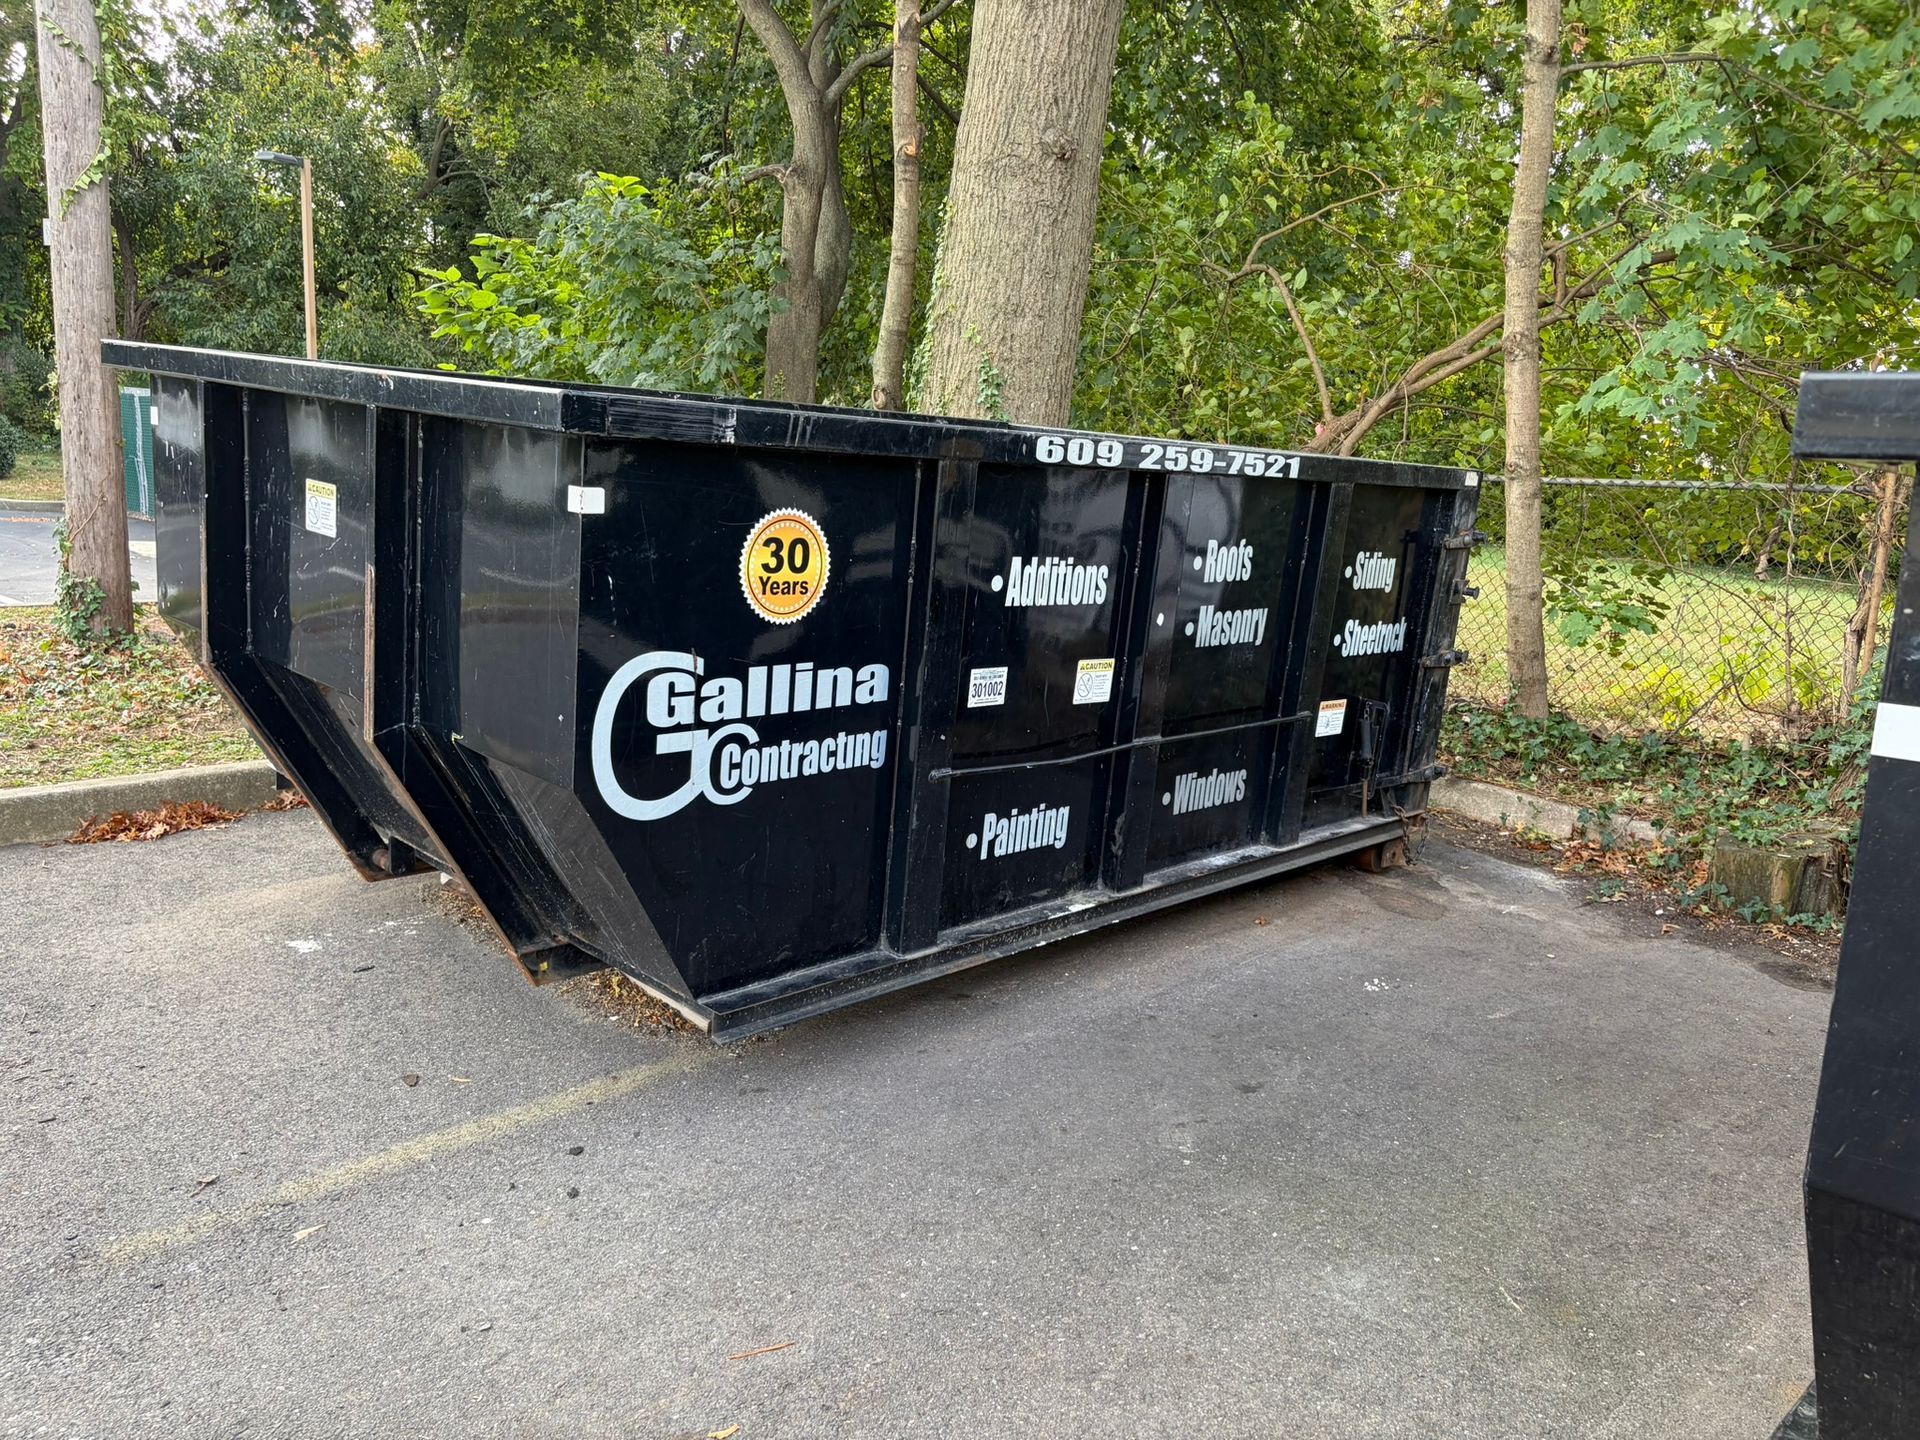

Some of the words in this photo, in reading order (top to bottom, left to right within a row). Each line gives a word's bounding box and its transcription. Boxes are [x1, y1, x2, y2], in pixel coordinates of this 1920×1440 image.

[1035, 436, 1124, 467] 609
[1139, 444, 1301, 479] 259-7521
[761, 537, 810, 574] 30
[1203, 538, 1254, 583] Roofs
[1352, 551, 1397, 593] Siding
[758, 576, 809, 596] Years
[1004, 556, 1109, 607] Additions
[1195, 604, 1269, 648] Masonry
[1341, 616, 1408, 658] Sheetrock
[1085, 661, 1113, 671] CAUTION
[646, 661, 890, 728] Gallina
[971, 680, 1004, 699] 301002
[719, 729, 888, 790] Contracting
[1172, 767, 1247, 816] Windows
[980, 802, 1070, 861] Painting
